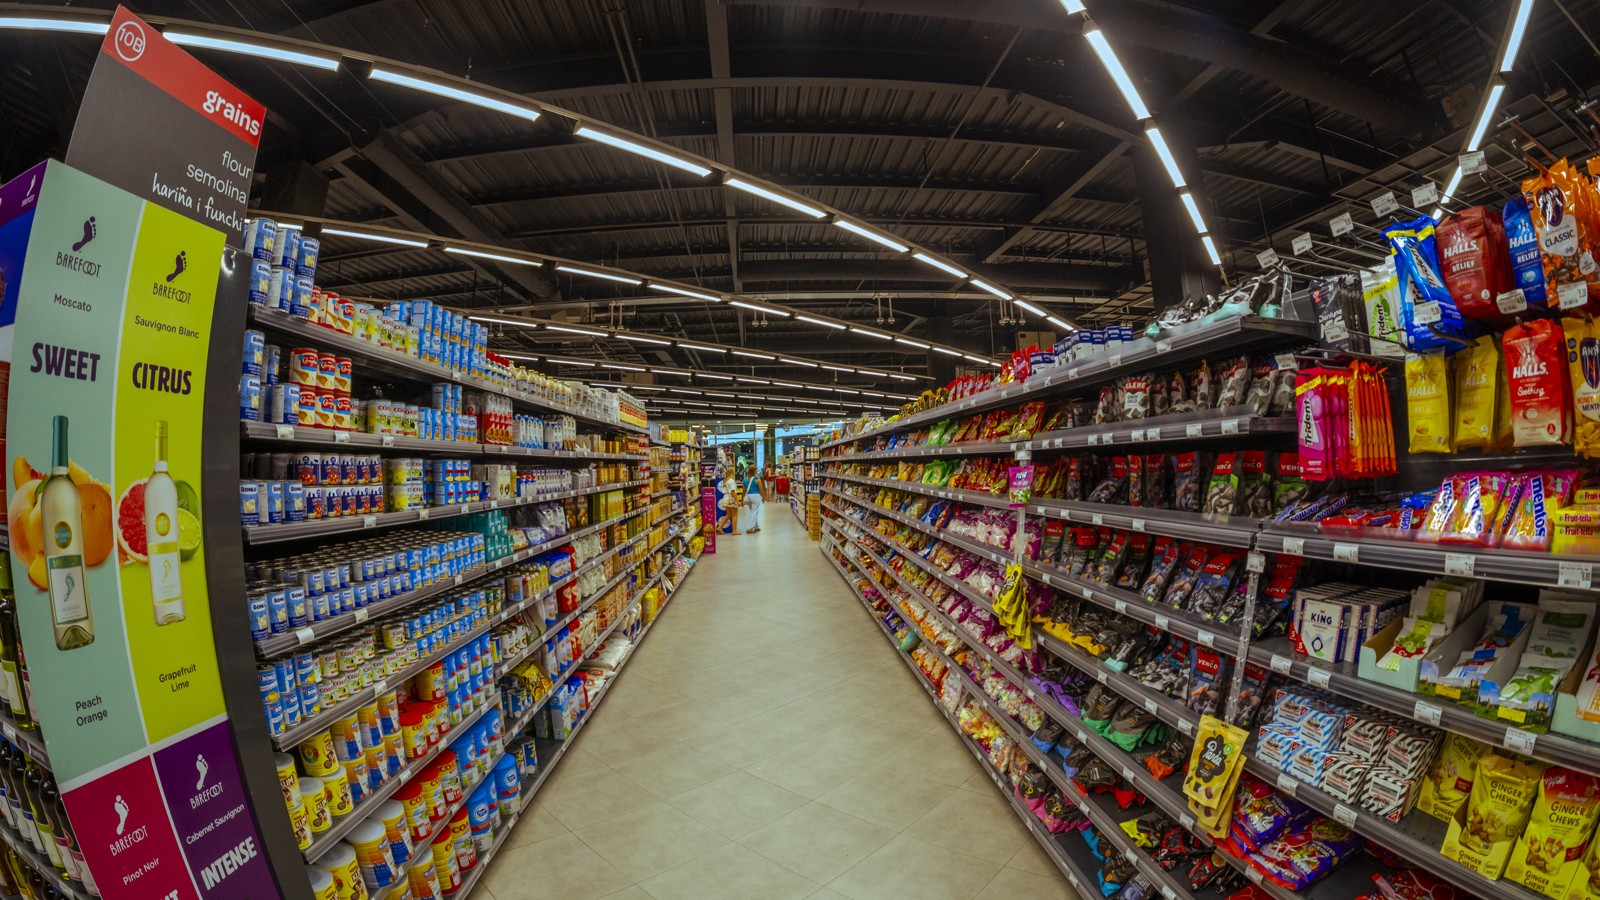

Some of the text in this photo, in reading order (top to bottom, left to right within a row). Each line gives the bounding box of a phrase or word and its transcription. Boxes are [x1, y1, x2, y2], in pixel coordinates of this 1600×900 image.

[120, 27, 143, 53] 10B
[202, 90, 260, 136] grains
[222, 151, 252, 179] flour
[187, 164, 247, 204] semolina
[152, 173, 242, 232] hariña i funchi
[1509, 232, 1537, 249] HALL
[1544, 229, 1576, 248] CLASSIC
[1443, 239, 1478, 259] HALLS
[1517, 250, 1539, 264] RELIEF
[56, 251, 101, 278] BAREFOOT
[1452, 260, 1475, 273] RELIEF
[53, 293, 92, 312] Moscato
[152, 282, 192, 304] BAREFOOT
[135, 315, 200, 339] Sauvignon Blanc
[30, 342, 101, 382] SWEET
[1512, 361, 1547, 379] HALLS
[132, 361, 192, 395] CITRUS
[1409, 384, 1437, 397] HALLS
[1517, 386, 1546, 397] Soothing
[1303, 398, 1313, 447] Trident
[1531, 475, 1546, 537] mentos
[1310, 612, 1333, 625] KING
[158, 663, 197, 683] Grapefruit
[1197, 658, 1219, 670] VENCO
[171, 680, 190, 693] Lime
[75, 695, 102, 712] Peach
[76, 708, 108, 727] Orange
[1202, 740, 1223, 767] Panda
[189, 782, 224, 810] BAREFOOT
[1489, 789, 1519, 807] CHEWS
[1490, 780, 1523, 798] GINGER
[1433, 803, 1455, 817] GINGER
[1550, 801, 1586, 816] GINGER
[186, 804, 245, 844] Cabernet Sauvignon
[1548, 812, 1581, 827] CHEWS
[109, 826, 148, 857] BAREFOOT
[200, 835, 258, 891] INTENSE
[1457, 855, 1479, 872] CHEWS
[1458, 849, 1482, 866] GINGER
[122, 857, 160, 886] Pinot Noir
[1525, 870, 1549, 886] GINGER
[1523, 878, 1545, 893] CHEWS
